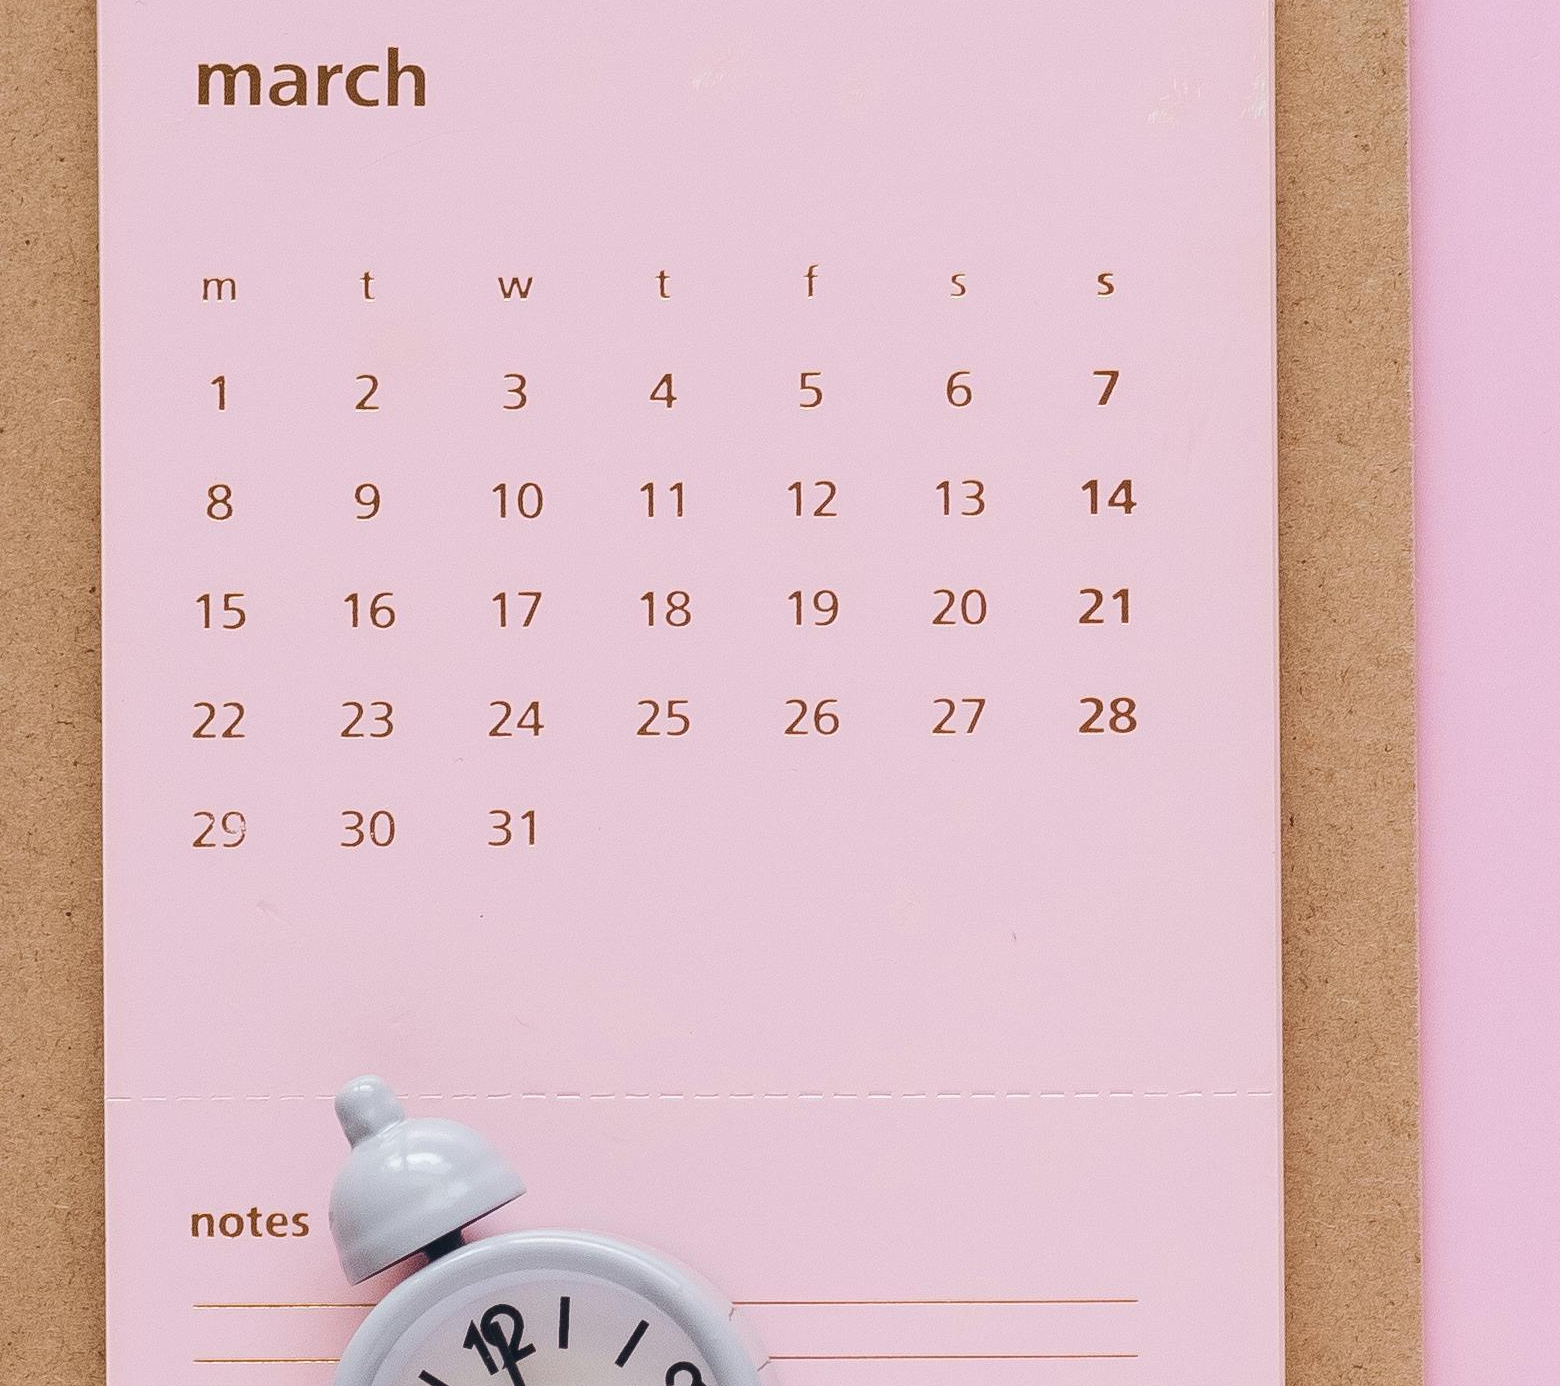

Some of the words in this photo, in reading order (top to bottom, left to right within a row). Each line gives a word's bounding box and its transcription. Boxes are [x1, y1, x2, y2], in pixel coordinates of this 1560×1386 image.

[197, 46, 426, 108] march
[202, 277, 237, 301] m
[359, 271, 375, 300] t
[497, 276, 533, 299] w
[655, 269, 671, 299] t
[803, 264, 819, 298] f
[950, 273, 966, 297] s
[1097, 272, 1115, 296] s
[210, 375, 226, 411] 1
[355, 374, 380, 411] 2
[503, 373, 527, 410] 3
[649, 373, 678, 409] 4
[799, 371, 823, 408] 5
[946, 370, 973, 408] 6
[1092, 370, 1120, 406] 7
[206, 483, 234, 521] 8
[354, 483, 381, 520] 9
[492, 482, 544, 519] 10
[640, 481, 684, 518] 11
[787, 480, 838, 517] 12
[935, 479, 985, 516] 13
[1081, 479, 1138, 515] 14
[195, 593, 246, 630] 15
[343, 592, 396, 629] 16
[492, 591, 542, 628] 17
[640, 590, 692, 627] 18
[787, 589, 839, 626] 19
[932, 588, 987, 625] 20
[1078, 588, 1130, 624] 21
[192, 701, 246, 739] 22
[340, 701, 394, 738] 23
[488, 700, 545, 737] 24
[636, 699, 690, 736] 25
[784, 698, 840, 736] 26
[932, 698, 986, 734] 27
[1078, 697, 1138, 734] 28
[192, 811, 247, 848] 29
[340, 810, 396, 848] 30
[487, 809, 535, 847] 31
[190, 1206, 310, 1239] notes
[462, 1303, 537, 1376] 12
